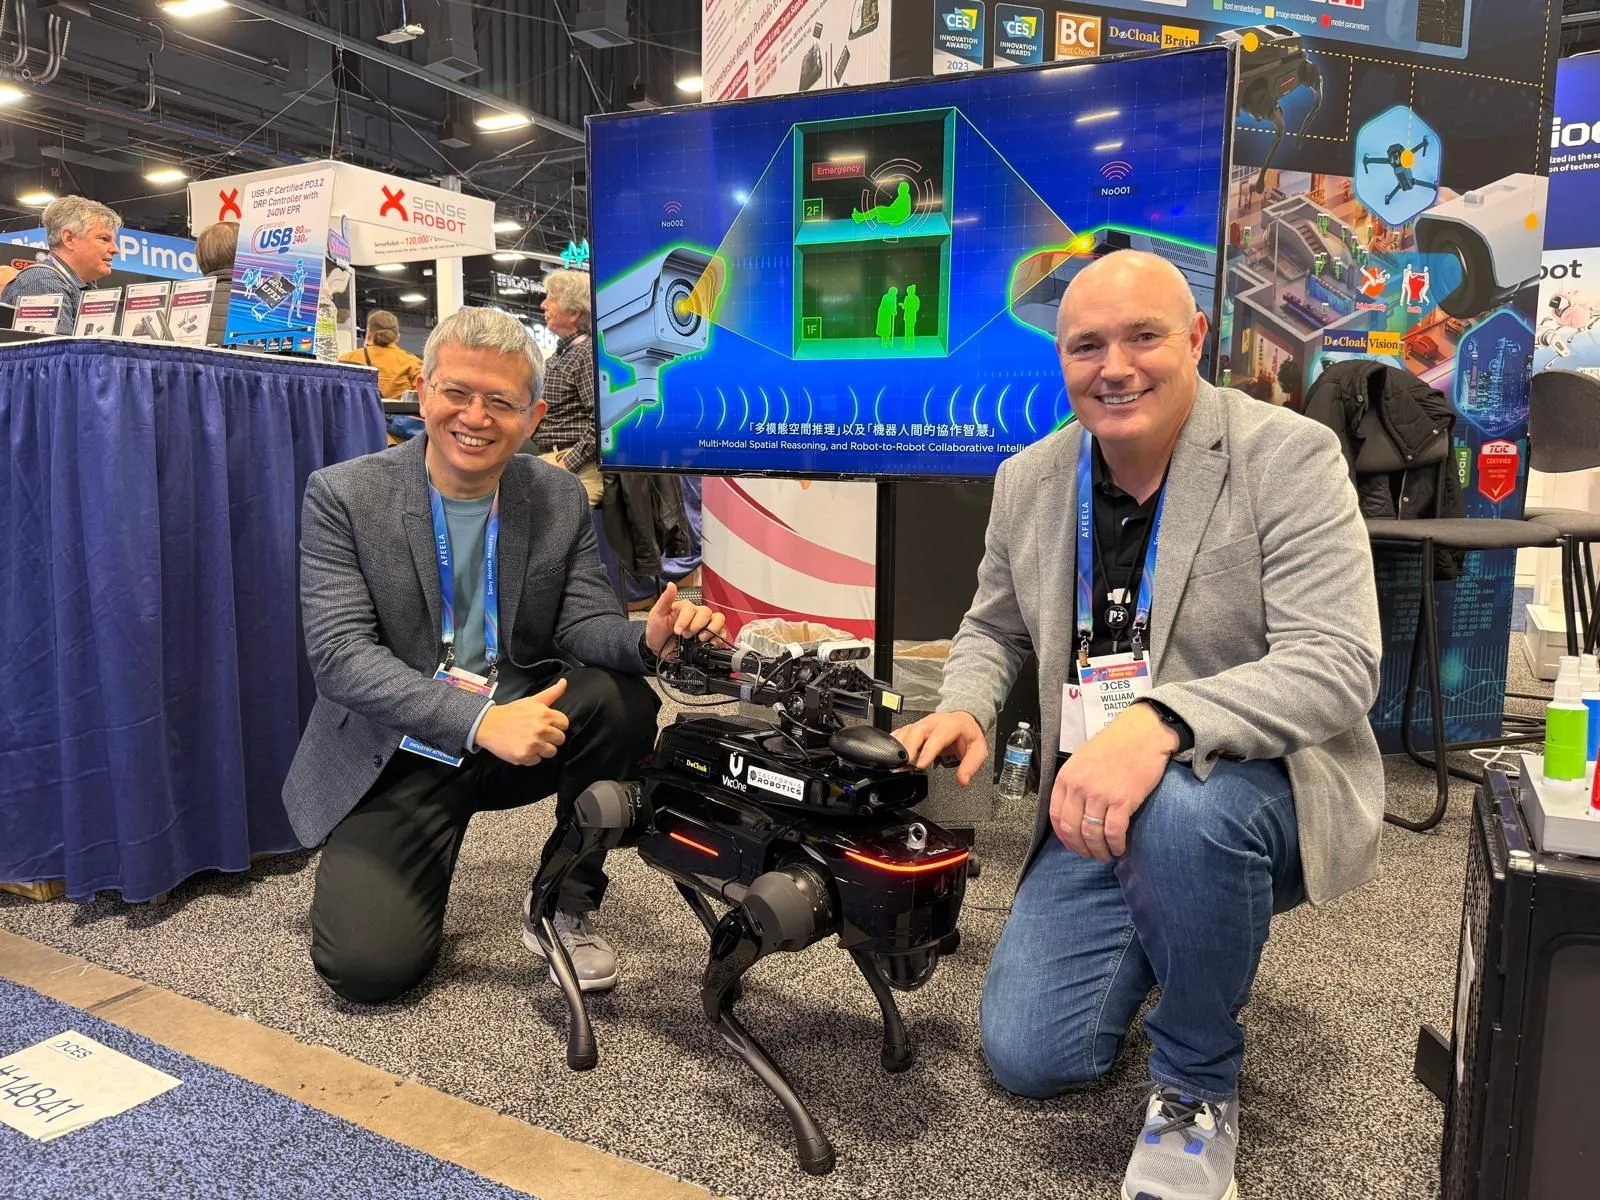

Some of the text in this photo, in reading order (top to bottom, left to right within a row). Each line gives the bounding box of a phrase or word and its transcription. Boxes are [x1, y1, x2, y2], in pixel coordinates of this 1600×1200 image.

[1234, 3, 1262, 15] embeddings
[947, 15, 970, 28] CES
[1290, 12, 1317, 23] embeddings
[1007, 22, 1030, 35] CES
[1331, 18, 1370, 31] model parameters
[940, 34, 978, 44] INNOVATION
[1060, 18, 1095, 48] BC
[946, 42, 972, 50] AWARDS
[1000, 41, 1037, 51] INNOVATION
[1165, 34, 1196, 48] Brain
[1006, 48, 1031, 57] AWARDS
[1075, 47, 1095, 56] Choice
[947, 60, 969, 71] 2023
[1568, 154, 1576, 162] in
[1578, 153, 1592, 161] the
[817, 164, 861, 176] Emergency
[251, 178, 325, 199] USB-IF Certified PD3.2
[1101, 186, 1131, 196] No001
[253, 190, 319, 209] DRP Controller with
[267, 204, 301, 218] 240W EPR
[413, 196, 467, 221] SENSE
[806, 206, 819, 216] 2F
[413, 211, 467, 235] ROBOT
[260, 227, 293, 249] USB
[119, 235, 202, 274] Pima
[806, 324, 817, 335] 1F
[1369, 338, 1398, 350] Vision
[699, 440, 747, 449] Multi-Modal
[749, 440, 778, 450] Spatial
[780, 440, 829, 451] Reasoning,
[831, 441, 848, 450] and
[850, 441, 926, 452] Robot-to-Robot
[928, 442, 994, 453] Collaborative
[1081, 501, 1089, 538] AFEELA
[438, 533, 449, 566] AFEELA
[1110, 680, 1131, 690] CES
[1100, 692, 1135, 703] WILLIAM
[409, 742, 432, 753] INDUSTRY
[722, 774, 747, 792] VicOne
[757, 771, 802, 789] CALIFORNIA
[757, 777, 802, 796] ROBOTICS
